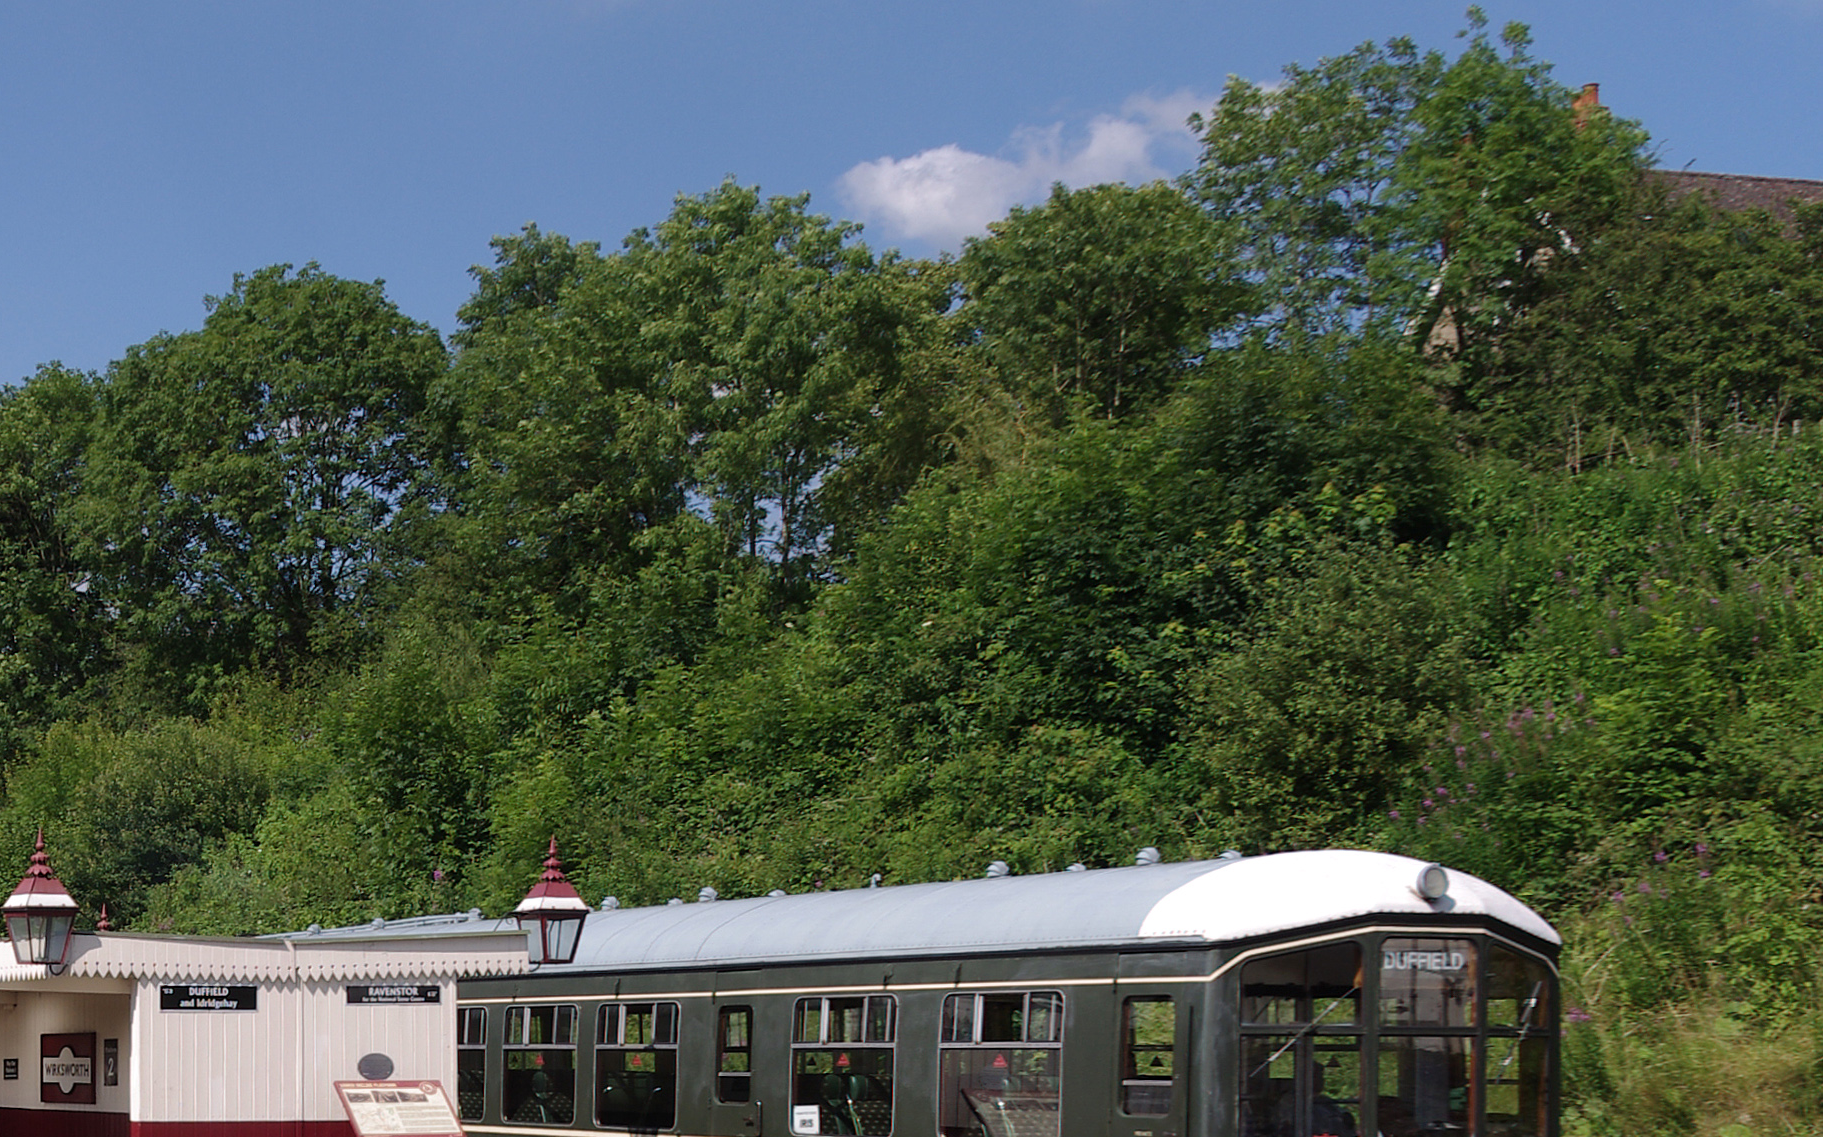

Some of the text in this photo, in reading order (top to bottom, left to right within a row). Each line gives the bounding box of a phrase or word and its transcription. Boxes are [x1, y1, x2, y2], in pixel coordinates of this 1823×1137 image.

[1384, 951, 1464, 970] DUFFIELD
[188, 987, 229, 996] DUFFIELD
[368, 987, 419, 997] RAVENSTOR
[179, 998, 195, 1007] and
[45, 1063, 90, 1077] WIRKSWORTH
[107, 1057, 115, 1077] 2
